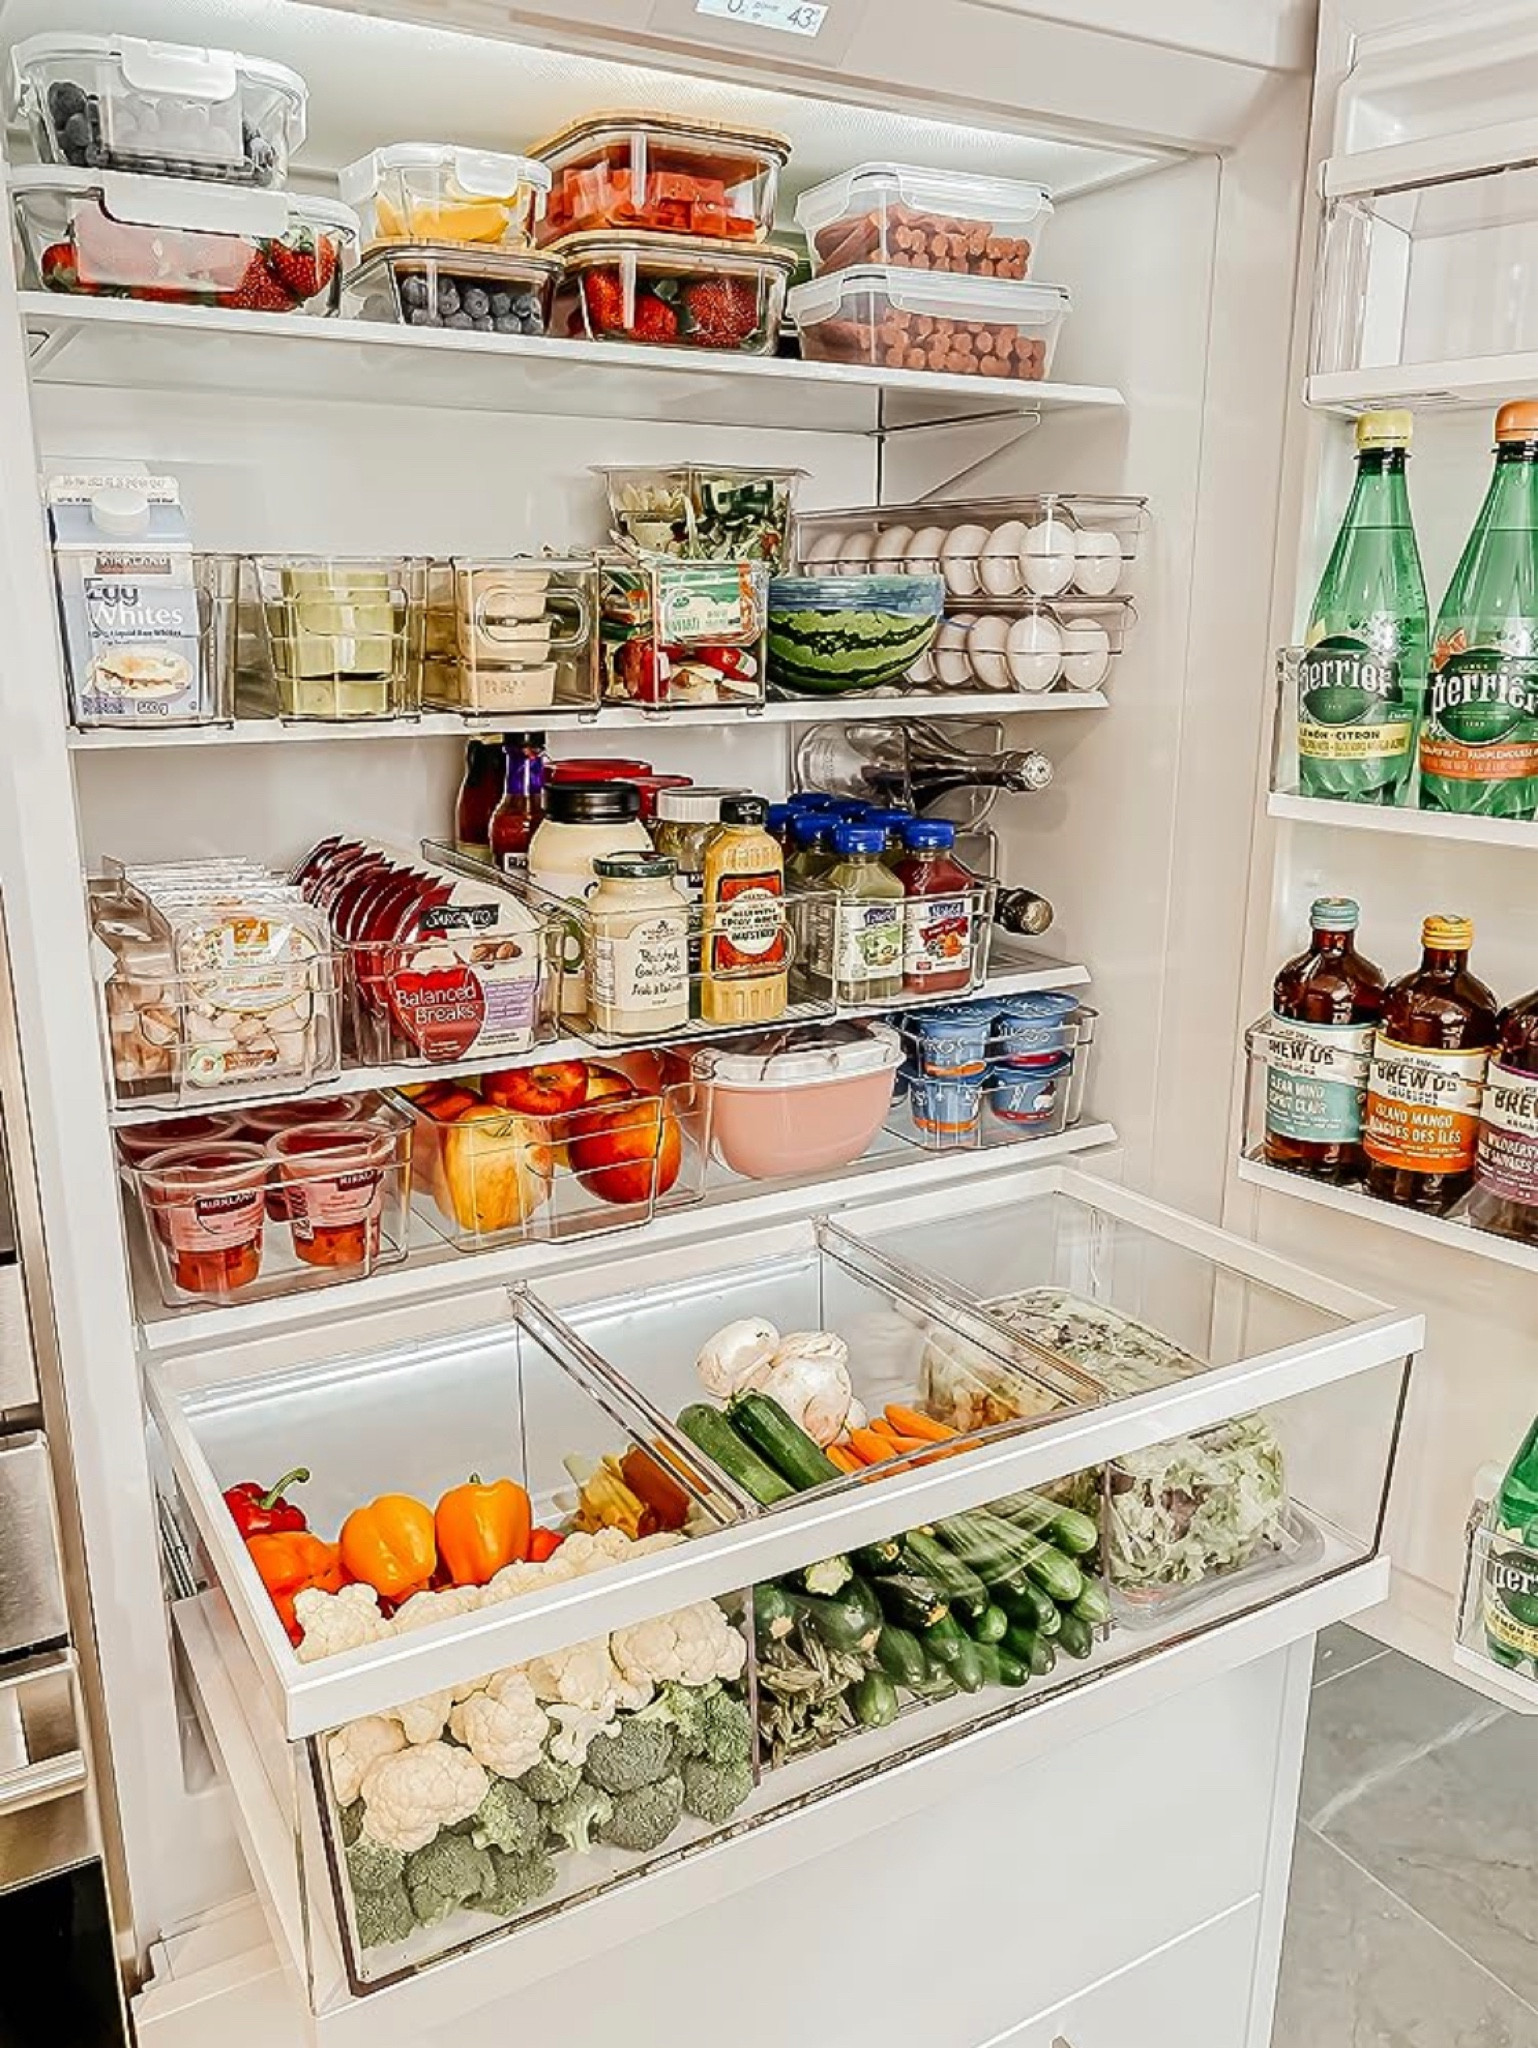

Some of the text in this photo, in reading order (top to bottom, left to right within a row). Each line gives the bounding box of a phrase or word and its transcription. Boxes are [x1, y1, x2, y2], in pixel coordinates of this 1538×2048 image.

[83, 577, 139, 607] Egg
[89, 604, 184, 627] Whites
[1336, 731, 1381, 740] CITRON
[396, 982, 477, 1008] Balanced
[415, 1004, 476, 1024] Breaks
[1411, 1112, 1453, 1128] MANGO
